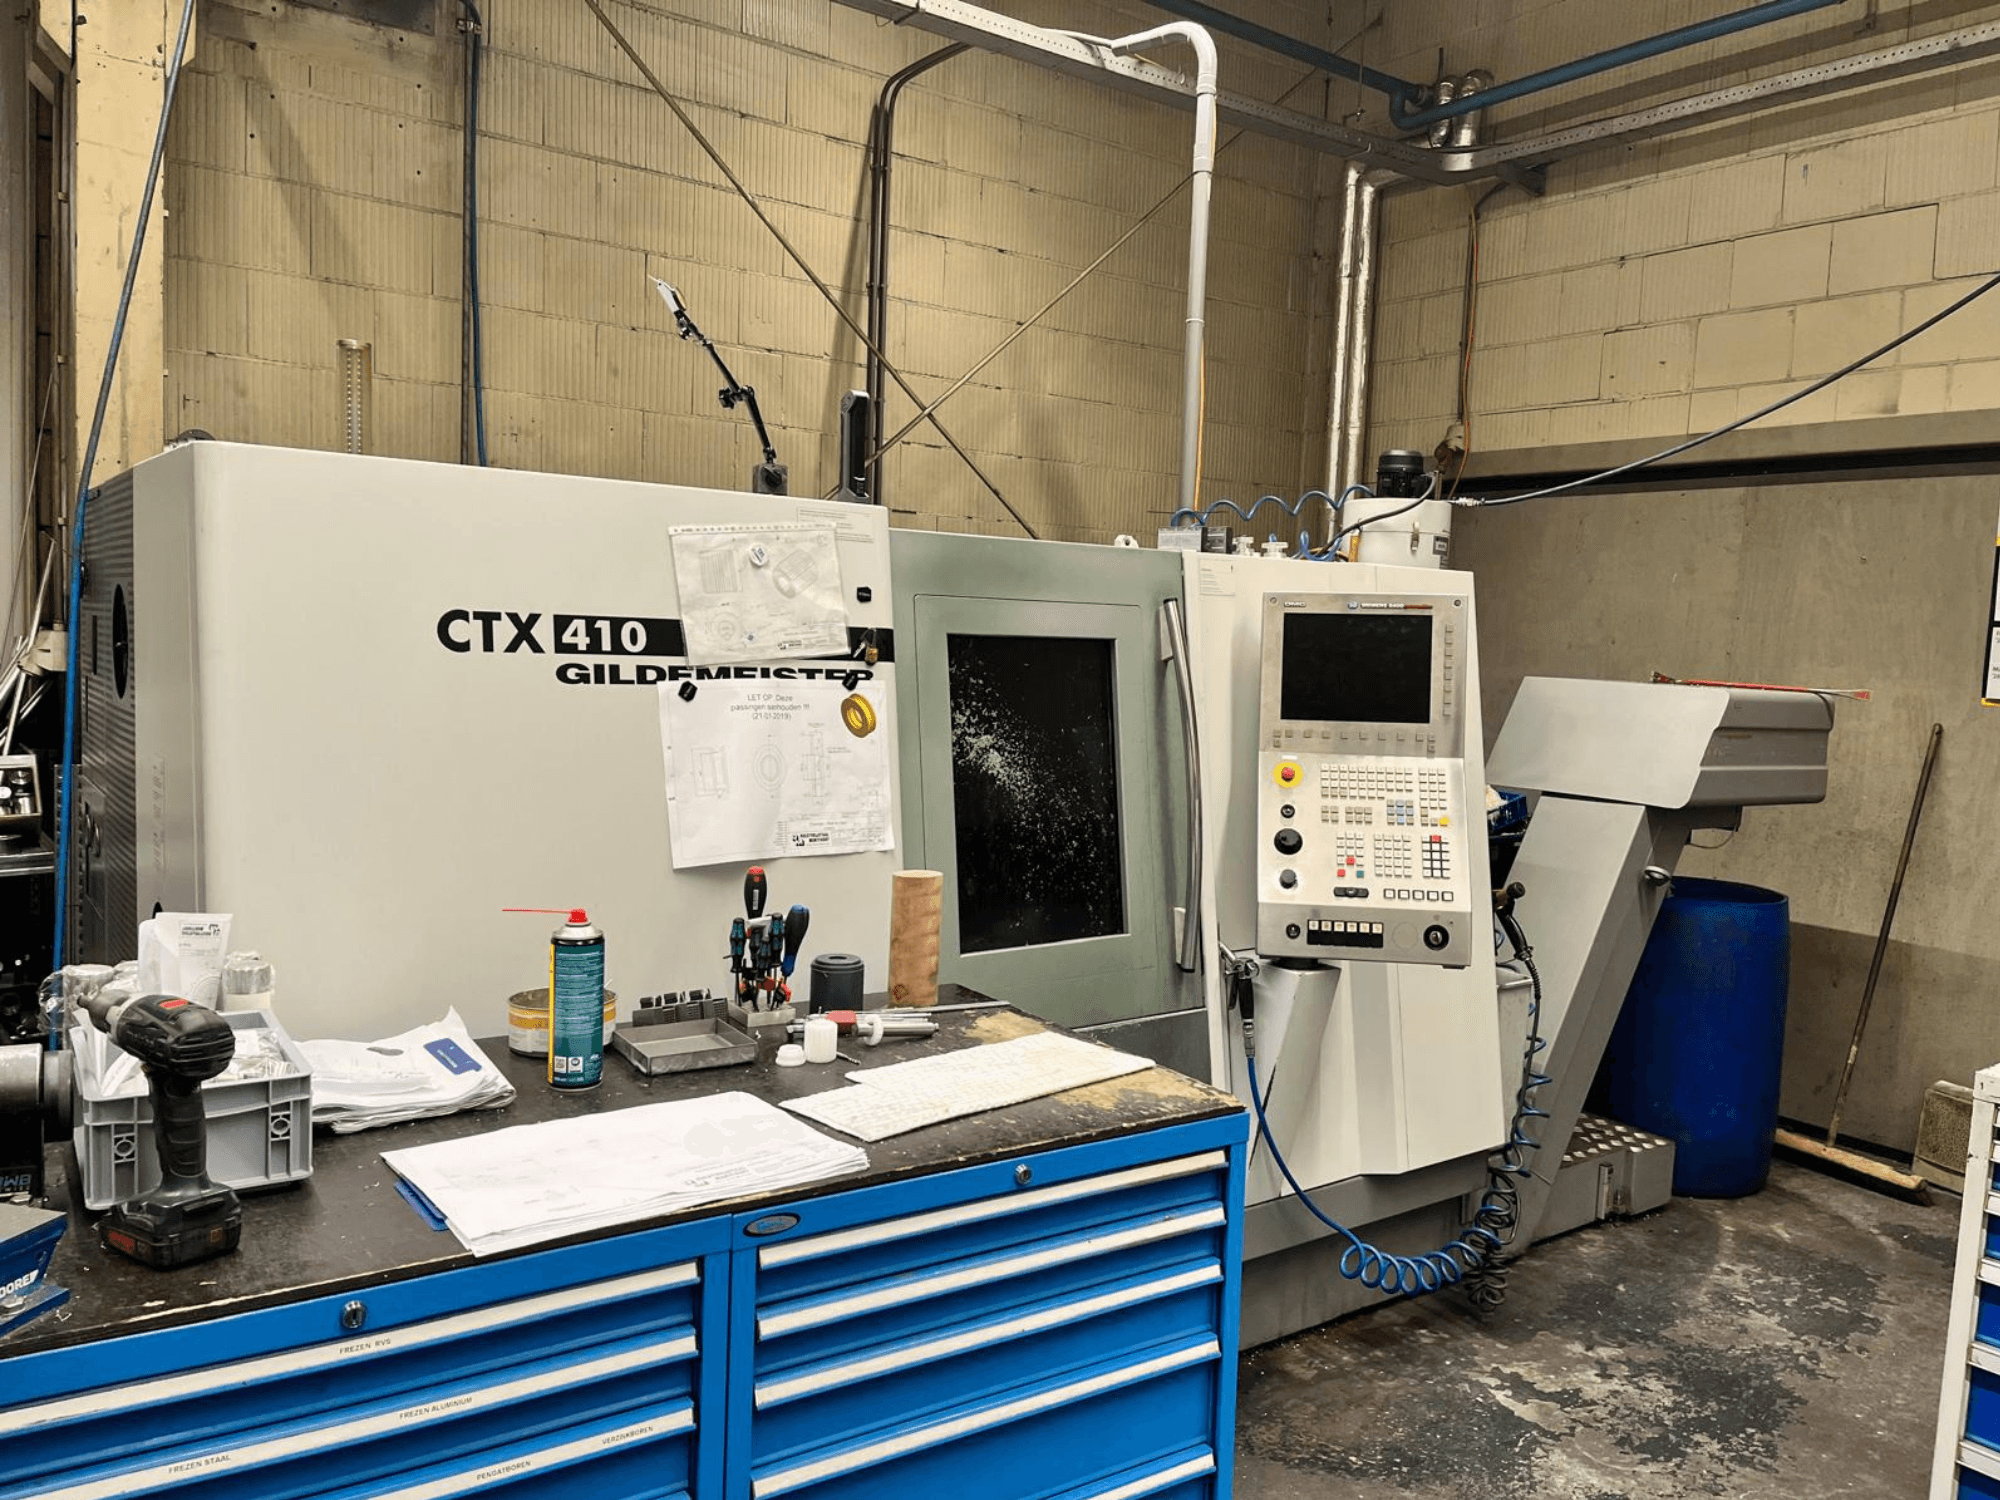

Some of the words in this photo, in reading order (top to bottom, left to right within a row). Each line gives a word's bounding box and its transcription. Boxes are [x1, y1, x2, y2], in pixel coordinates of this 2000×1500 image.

[437, 609, 546, 654] CTX
[561, 618, 648, 653] 410
[339, 1342, 371, 1354] FREZEN
[399, 1407, 430, 1419] FREZEN
[168, 1461, 203, 1474] FREZEN
[204, 1454, 231, 1466] STAAL
